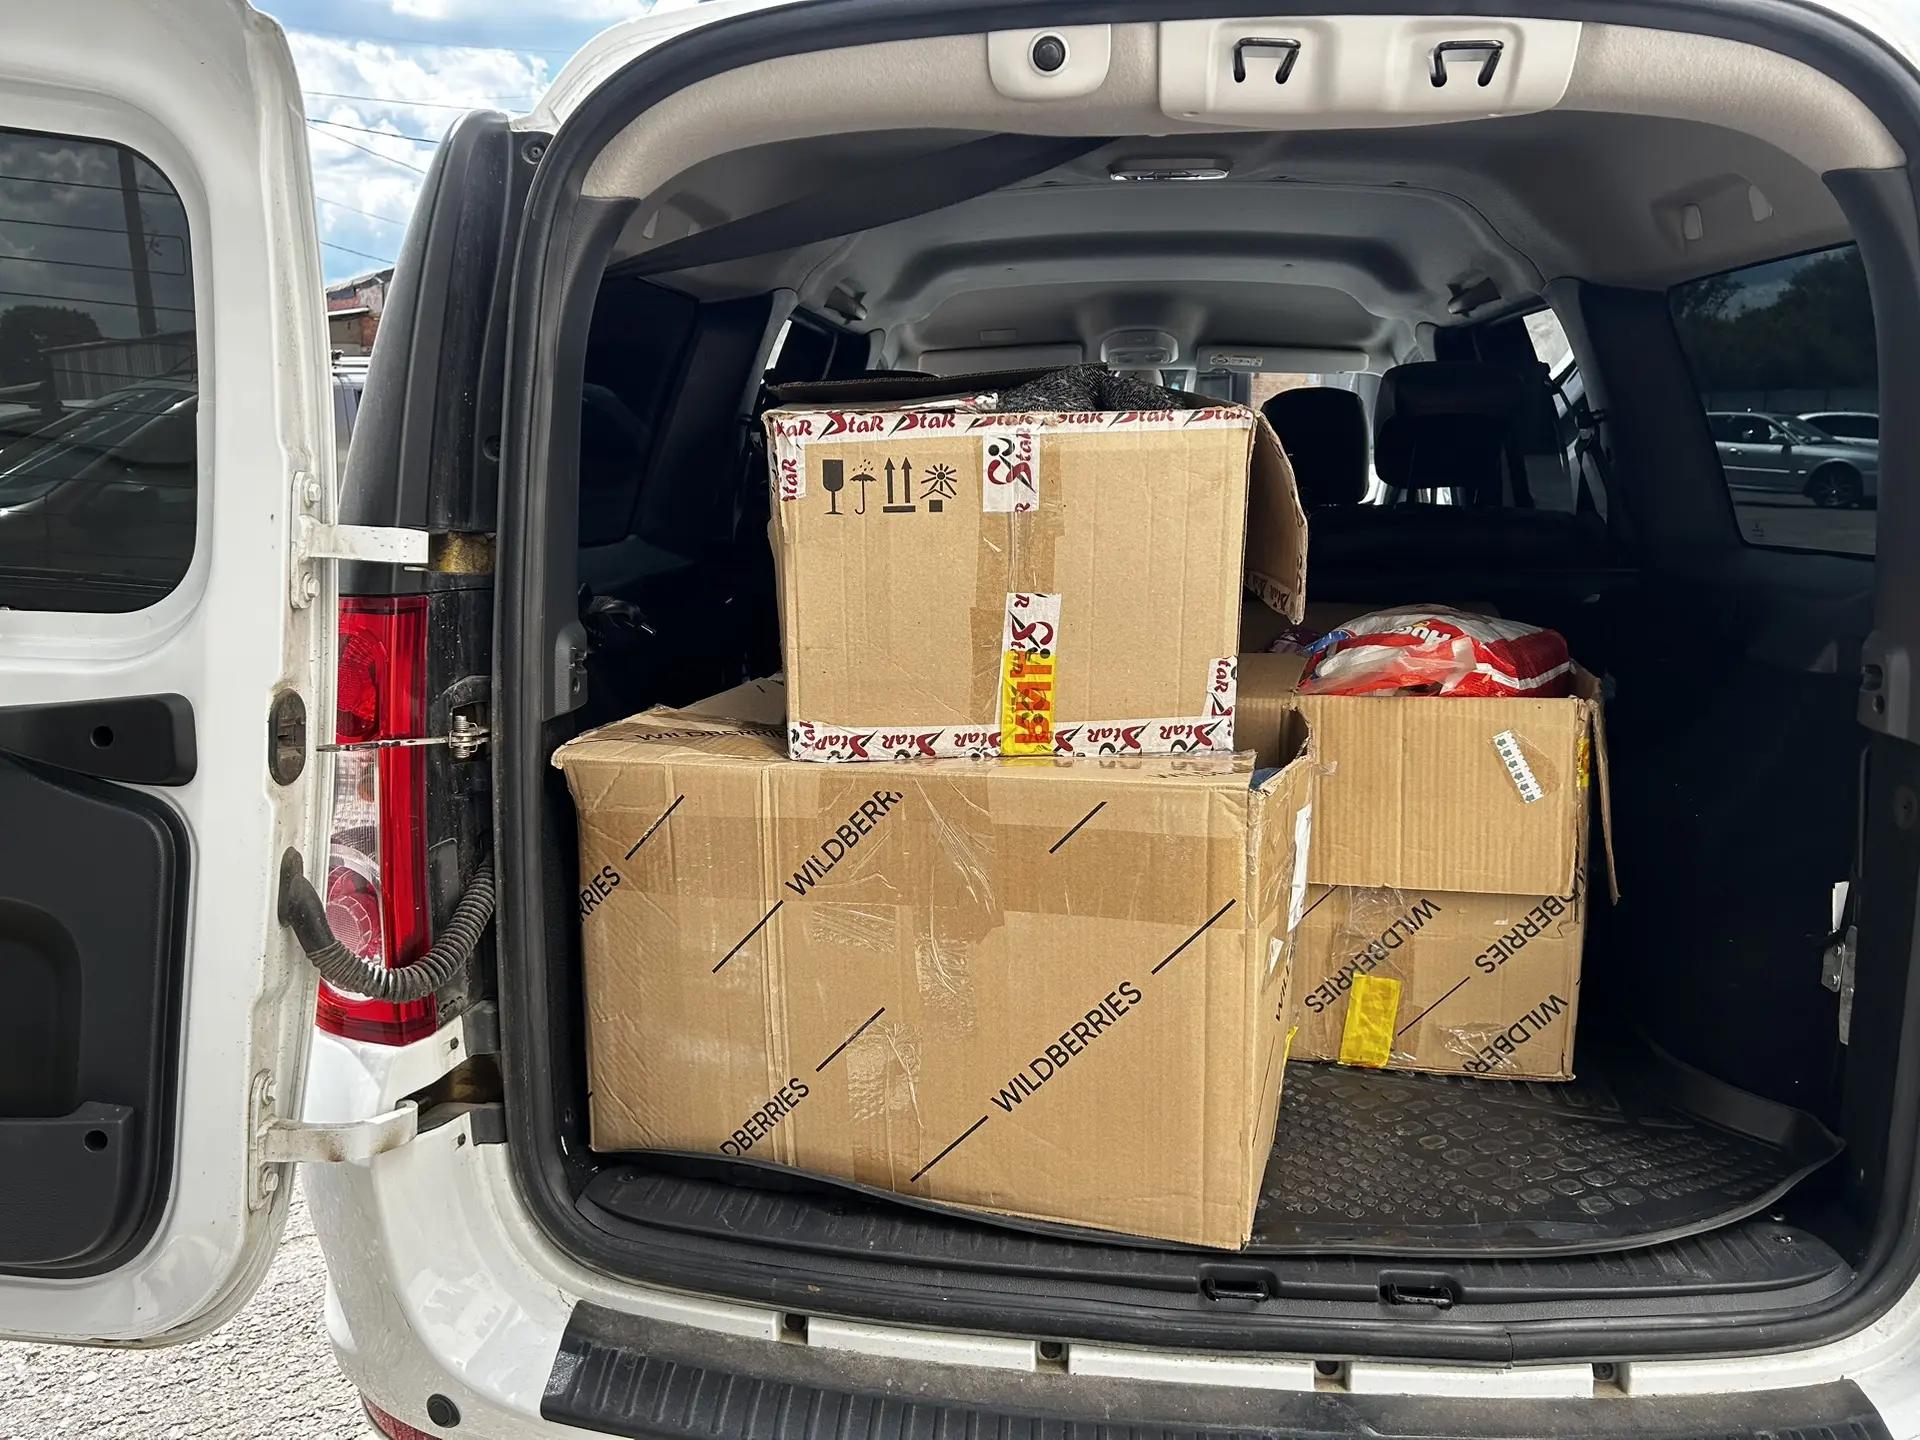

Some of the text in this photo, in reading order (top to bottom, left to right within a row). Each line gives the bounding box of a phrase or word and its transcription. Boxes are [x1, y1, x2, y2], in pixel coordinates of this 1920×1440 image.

[818, 411, 885, 440] StaR
[887, 413, 956, 437] StaR
[881, 728, 946, 757] StaR
[1087, 721, 1151, 751] StaR
[1160, 719, 1223, 752] StaR
[1304, 898, 1442, 1013] WILDBERRIES
[990, 981, 1143, 1112] WILDBERRIES
[719, 1077, 810, 1156] DBERRIES
